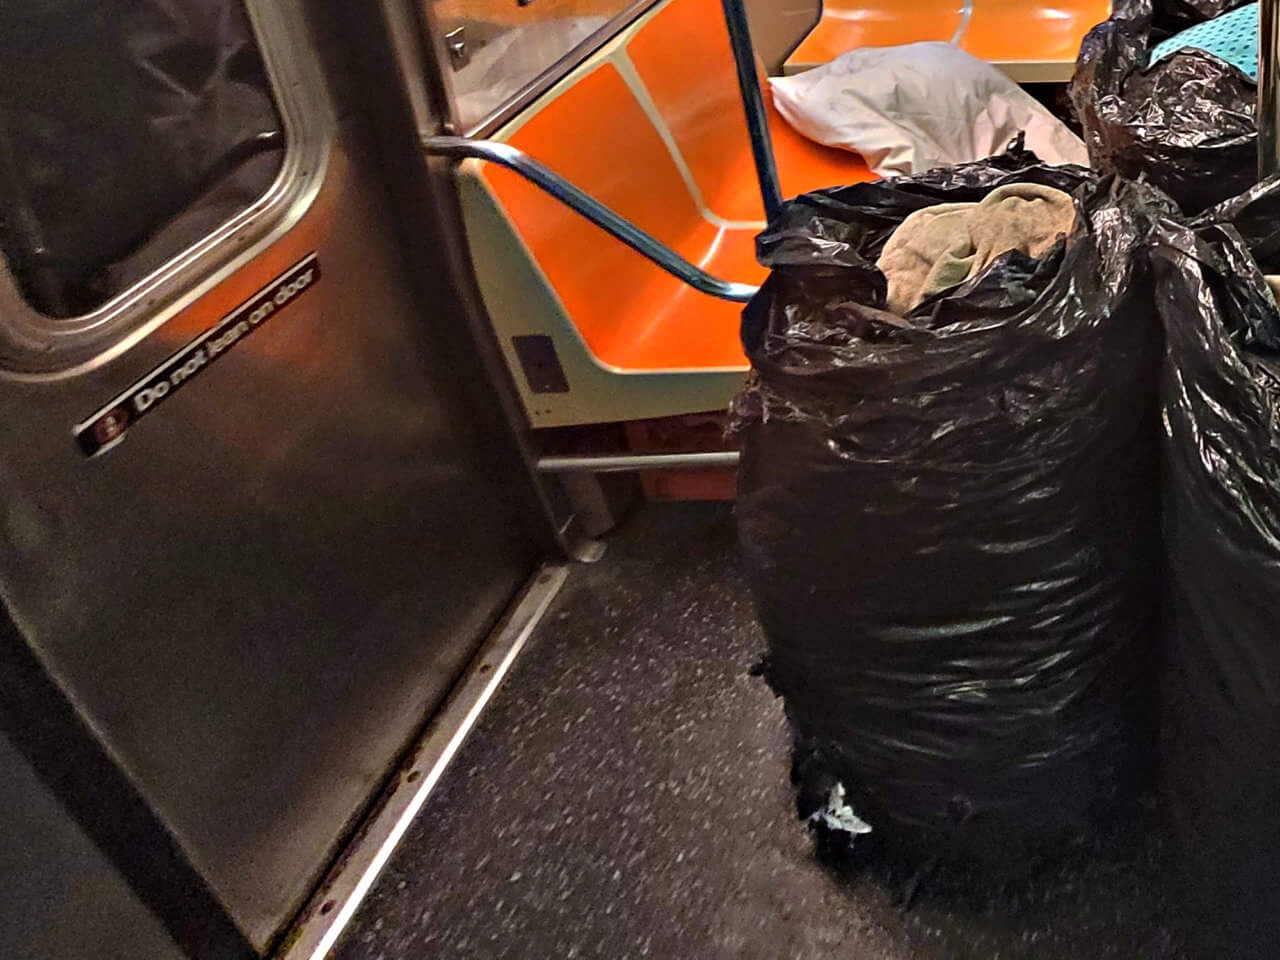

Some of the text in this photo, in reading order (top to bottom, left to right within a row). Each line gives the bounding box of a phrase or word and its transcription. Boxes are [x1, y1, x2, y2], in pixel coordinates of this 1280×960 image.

[135, 268, 313, 411] Do not lean on door
